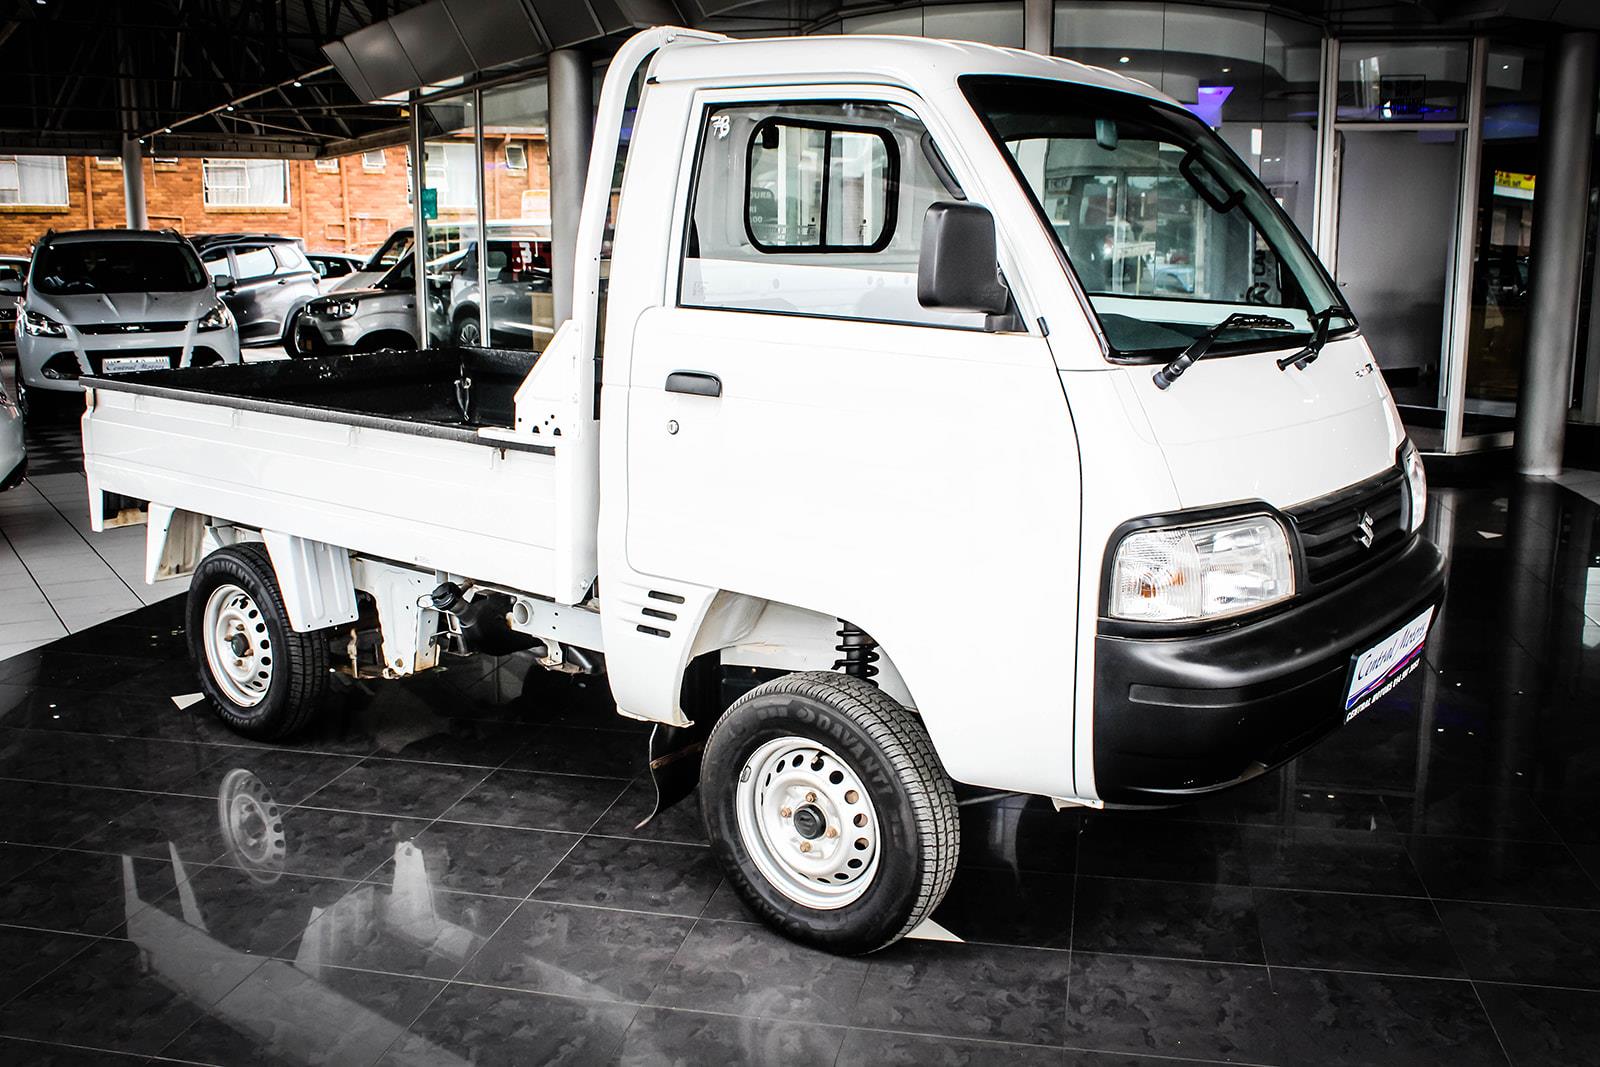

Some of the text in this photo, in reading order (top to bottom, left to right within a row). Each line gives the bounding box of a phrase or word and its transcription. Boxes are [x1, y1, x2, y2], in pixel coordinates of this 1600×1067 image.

[1358, 639, 1398, 680] Central
[1399, 623, 1427, 649] Motors
[816, 713, 894, 795] DAVANTI
